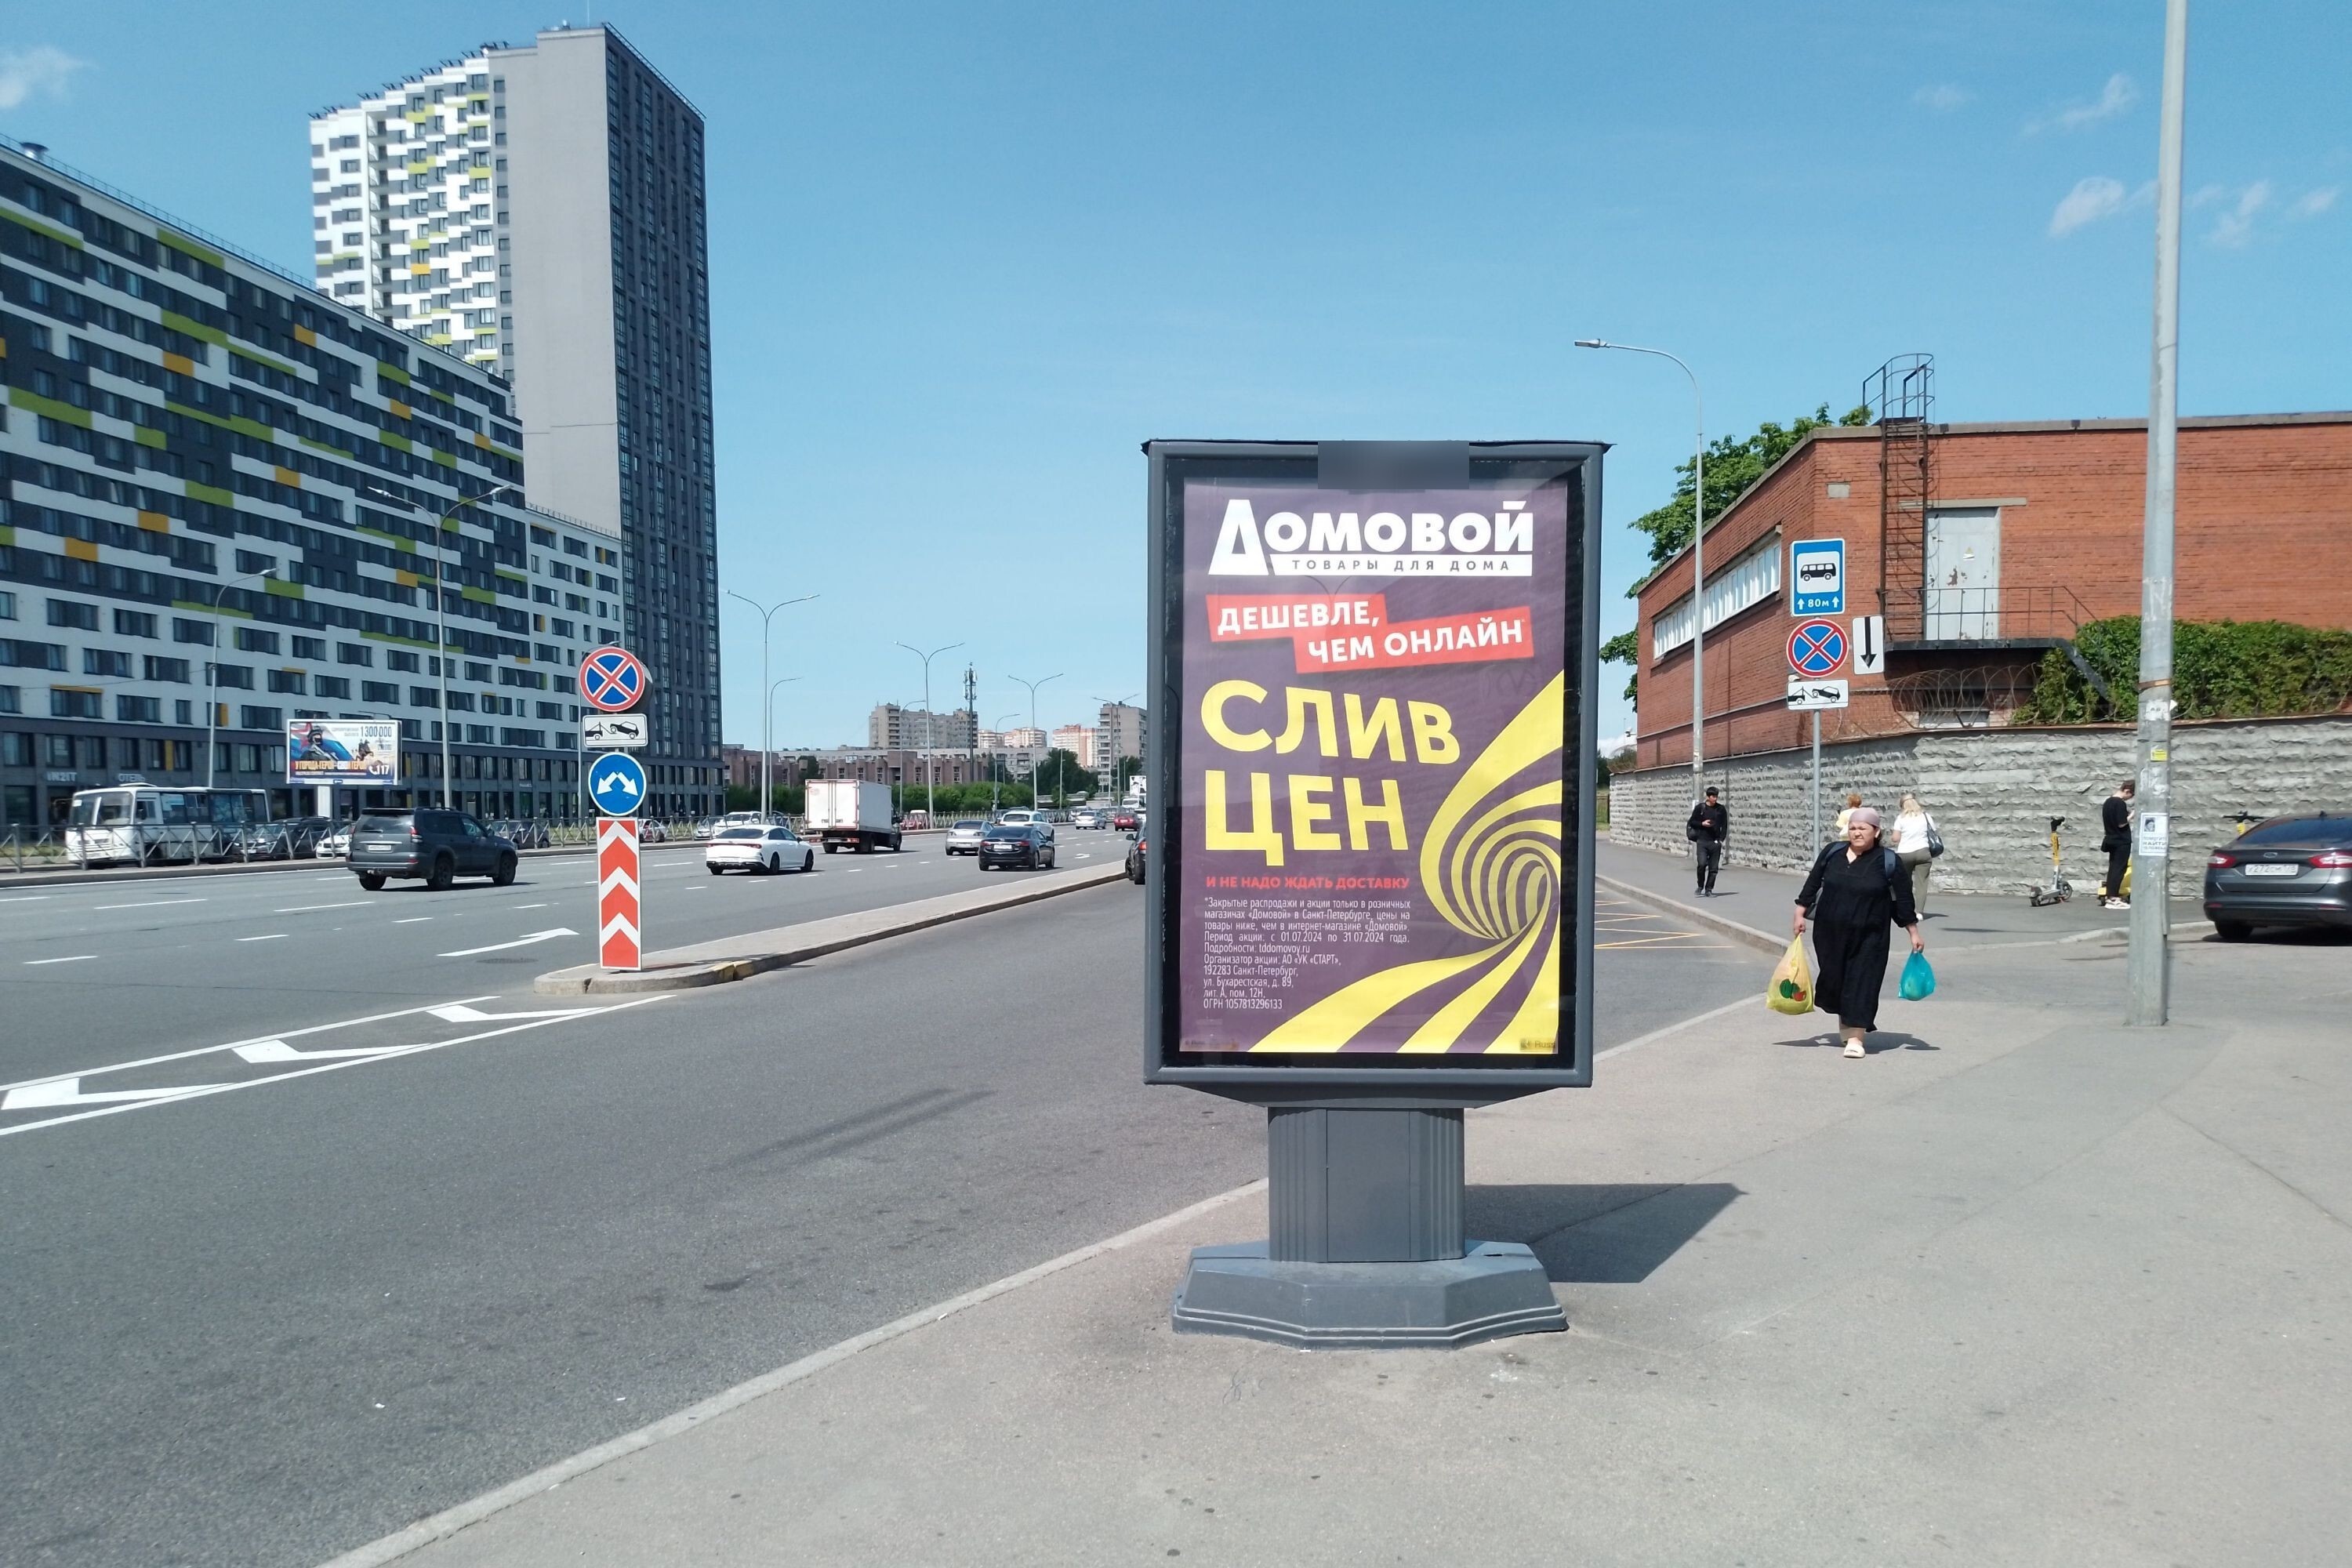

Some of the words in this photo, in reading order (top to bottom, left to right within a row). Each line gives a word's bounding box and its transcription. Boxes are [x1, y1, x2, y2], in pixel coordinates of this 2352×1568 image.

[1291, 559, 1379, 570] ТОВАРЫ
[1394, 560, 1435, 572] ДЛЯ
[1450, 561, 1510, 572] ДОМА
[1808, 598, 1829, 608] 80м
[1218, 601, 1380, 636] ДЕШЕВЛЕ,
[1308, 636, 1374, 663] ЧЕМ
[1201, 680, 1460, 765] СЛИВ
[1205, 770, 1409, 866] ЦЕН
[1207, 877, 1216, 887] И
[1220, 877, 1237, 887] НЕ
[1241, 877, 1280, 888] НАДО
[1285, 878, 1332, 888] ЖДАТЬ
[1336, 878, 1410, 889] ДОСТАВКУ
[1307, 900, 1330, 909] акции
[1368, 901, 1410, 909] розничных
[1248, 909, 1291, 920] «Домовой»
[1302, 910, 1373, 922] Санкт-Петербурге,
[1377, 911, 1397, 920] цены
[1205, 921, 1232, 932] товары
[1236, 922, 1258, 931] ниже,
[1288, 922, 1361, 933] интернет-магазине
[1365, 921, 1409, 932] «Домовой».
[1204, 932, 1232, 944] Период
[1239, 934, 1265, 943] акции:
[1281, 932, 1322, 942] 01.07.2024
[1390, 935, 1409, 943] года.
[1205, 944, 1257, 955] Подробности:
[1259, 944, 1310, 955] tddomovoy.ru
[1204, 955, 1252, 965] Организатор
[1254, 956, 1280, 965] акции:
[1283, 955, 1292, 964] АО
[1294, 955, 1308, 964] «УК
[1310, 955, 1341, 965] «СТАРТ»,
[1204, 966, 1231, 975] 192283
[1233, 967, 1298, 977] Санкт-Петербург,
[1204, 978, 1214, 989] ул.
[1217, 978, 1269, 989] Бухарестская,
[1272, 979, 1279, 988] д.
[1282, 976, 1294, 988] 89,
[1204, 999, 1223, 1009] ОГРН
[1225, 1000, 1282, 1009] 1057813296133
